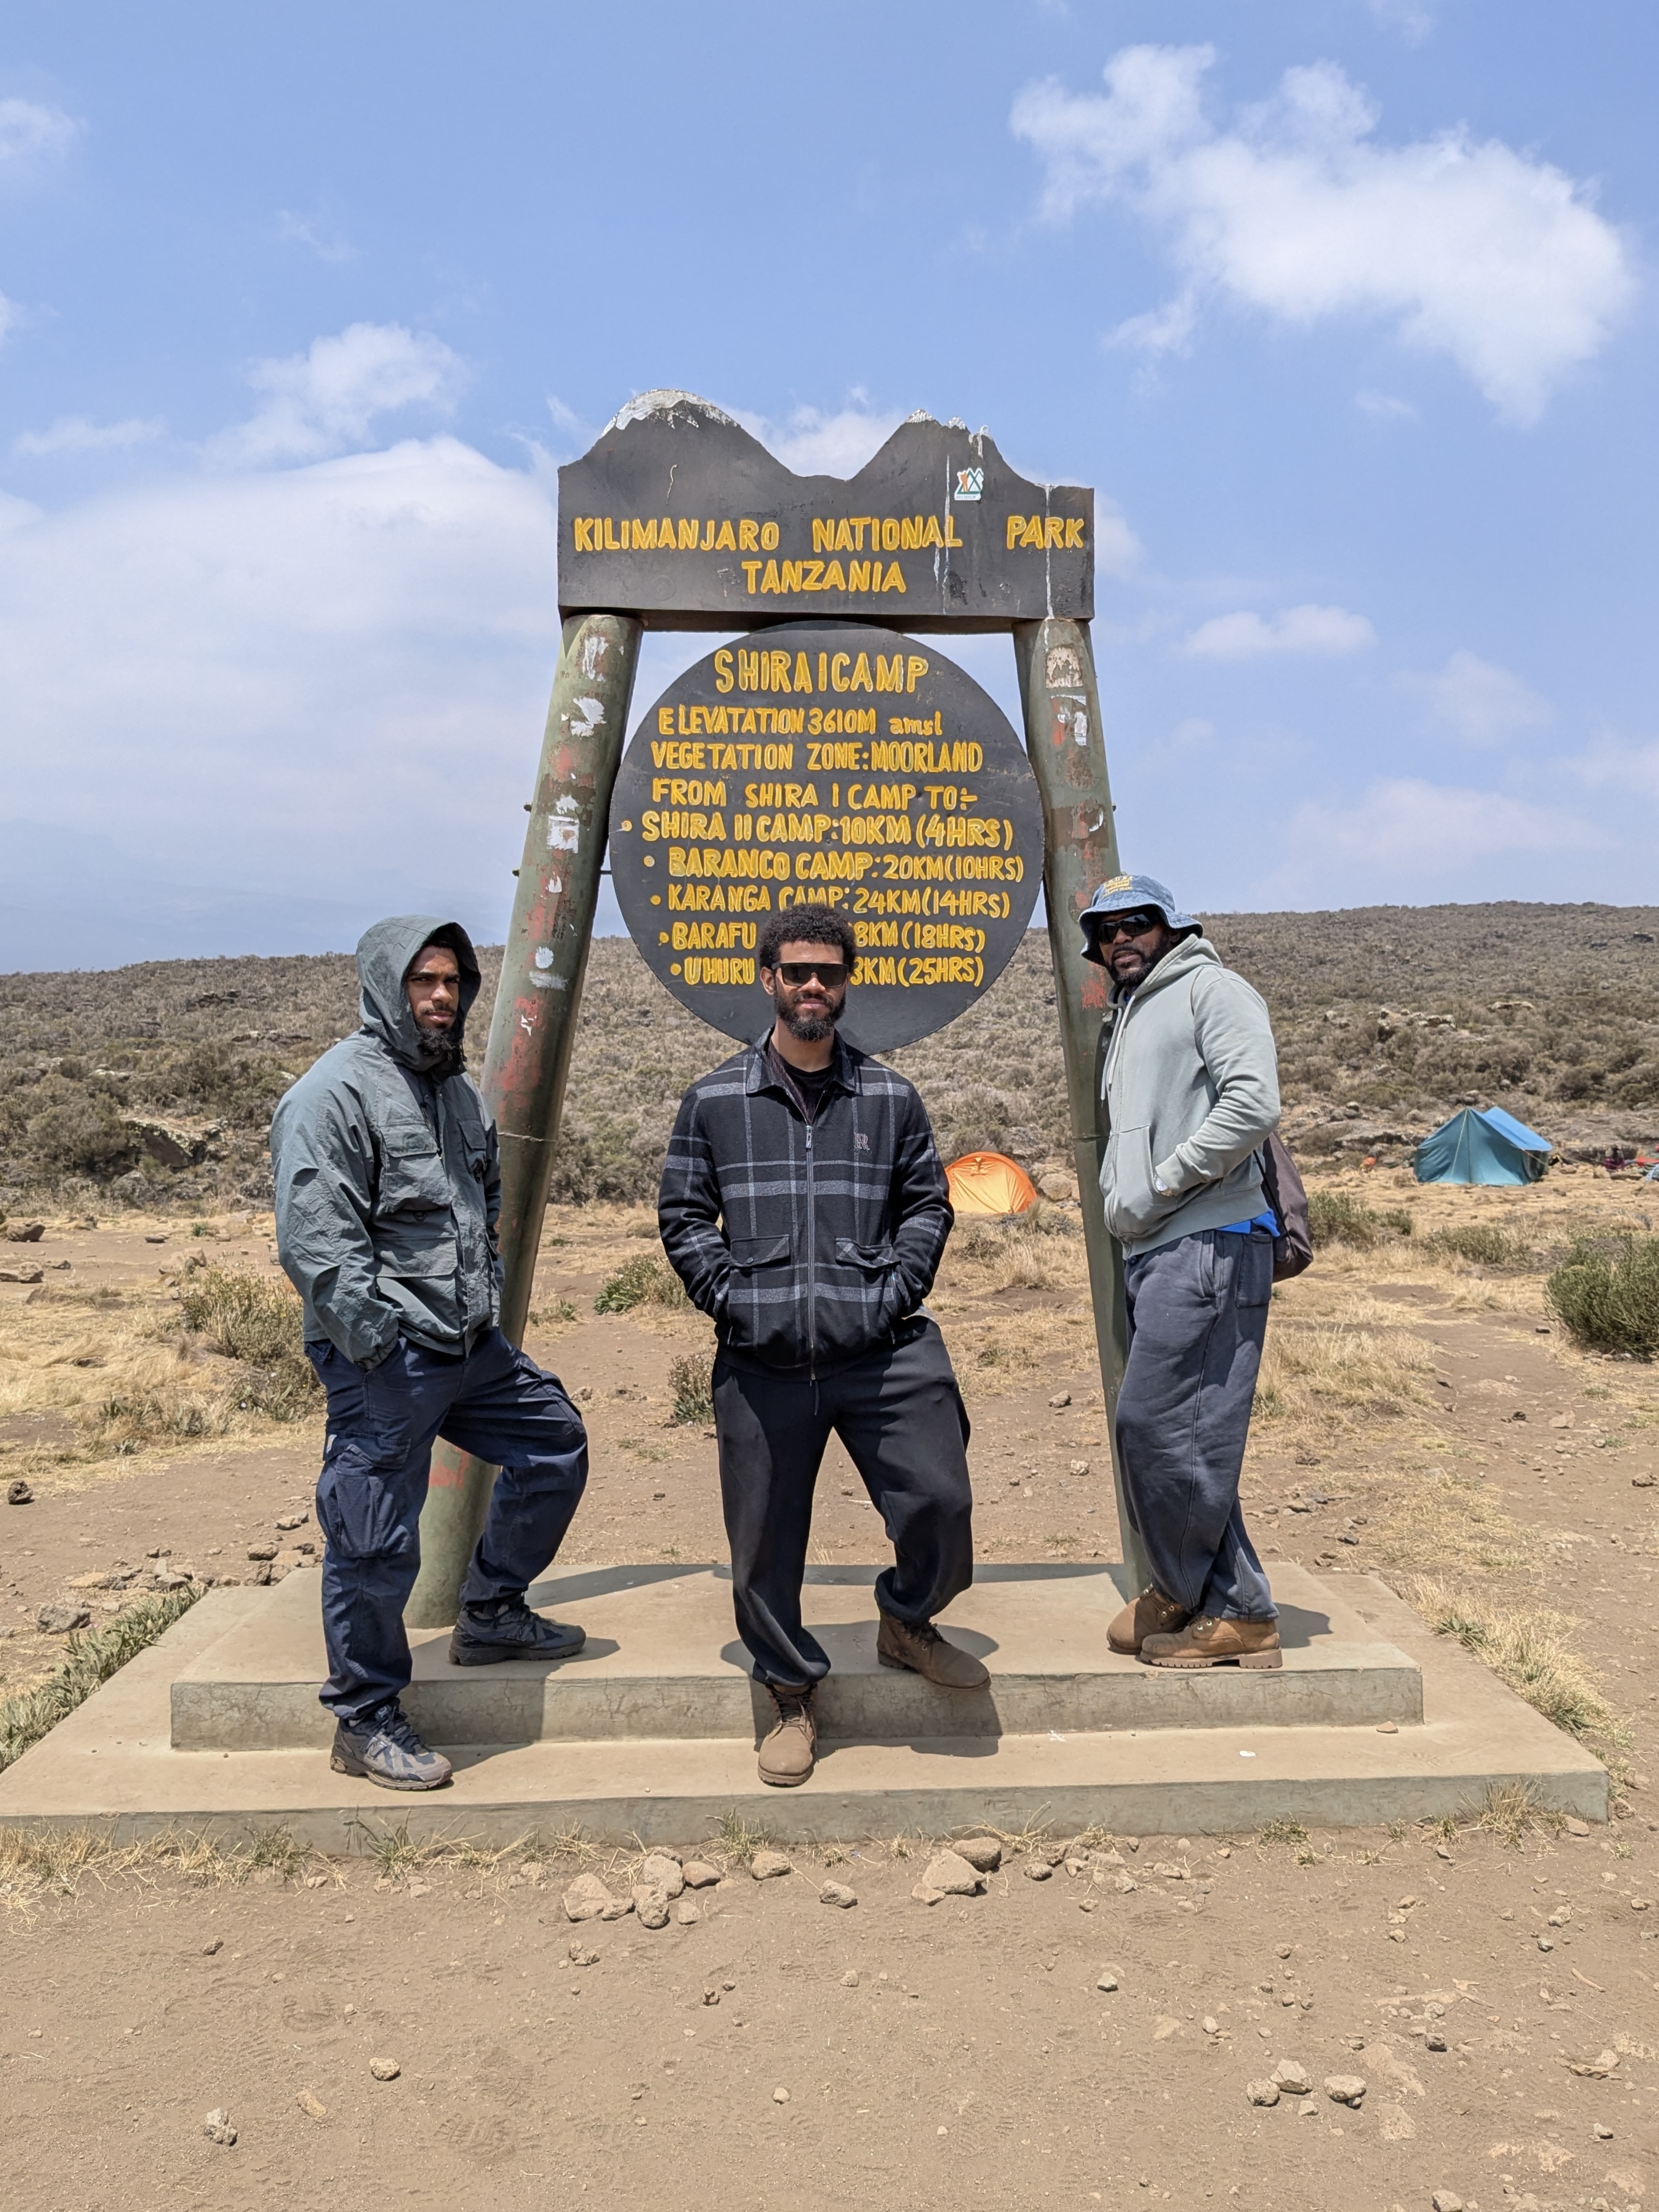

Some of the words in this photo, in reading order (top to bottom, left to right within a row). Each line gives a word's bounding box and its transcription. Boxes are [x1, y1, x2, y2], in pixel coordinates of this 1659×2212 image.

[573, 517, 779, 552] KILIMANJARO
[811, 515, 963, 552] NATIONAL
[1006, 514, 1085, 550] PARK
[741, 559, 907, 594] TANZANIA
[888, 710, 942, 736] amsl
[650, 740, 794, 770] VEGETATION
[652, 777, 727, 807] FROM
[744, 782, 819, 809] SHIRA
[831, 782, 840, 808] I
[847, 783, 916, 811] CAMP
[641, 810, 727, 842] SHIRA
[668, 846, 791, 881] BARANCO
[668, 883, 772, 912] KARANGA
[671, 921, 757, 951] BARAFU
[683, 956, 756, 986] UHURU
